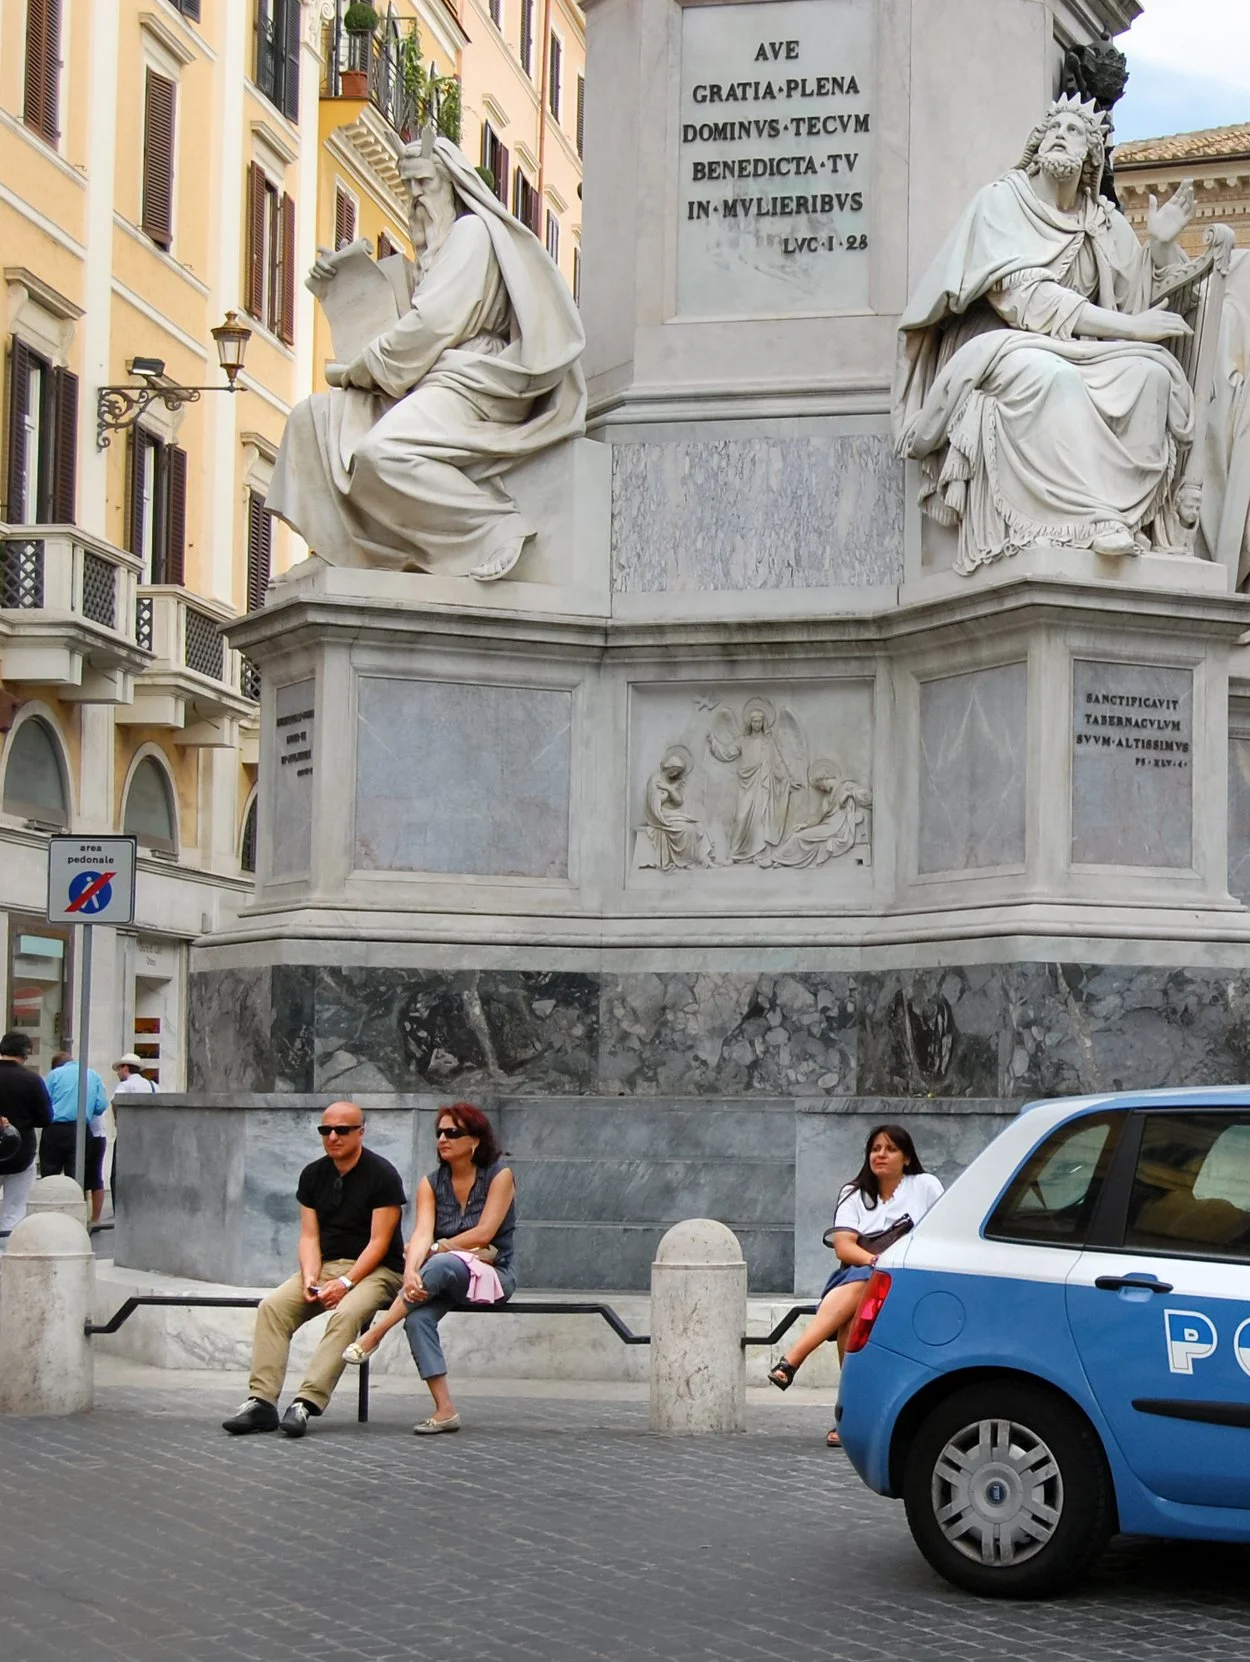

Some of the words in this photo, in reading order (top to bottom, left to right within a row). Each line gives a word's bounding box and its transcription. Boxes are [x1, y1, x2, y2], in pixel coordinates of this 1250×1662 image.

[754, 40, 800, 61] AVE
[693, 80, 777, 103] GRATIA
[786, 75, 860, 98] PLENA
[682, 119, 780, 143] DOMINVS
[791, 114, 870, 136] TECVM
[692, 156, 817, 181] BENEDICTA
[827, 153, 859, 173] TV
[687, 200, 711, 220] IN
[722, 192, 863, 218] MVLIERIBVS
[1086, 693, 1179, 710] SANCTIFICAVIT
[1085, 714, 1180, 731] TABERNACVLVM
[1076, 734, 1111, 747] SVVM
[1116, 737, 1189, 753] ALTISSIMVS
[67, 856, 114, 864] pedonale
